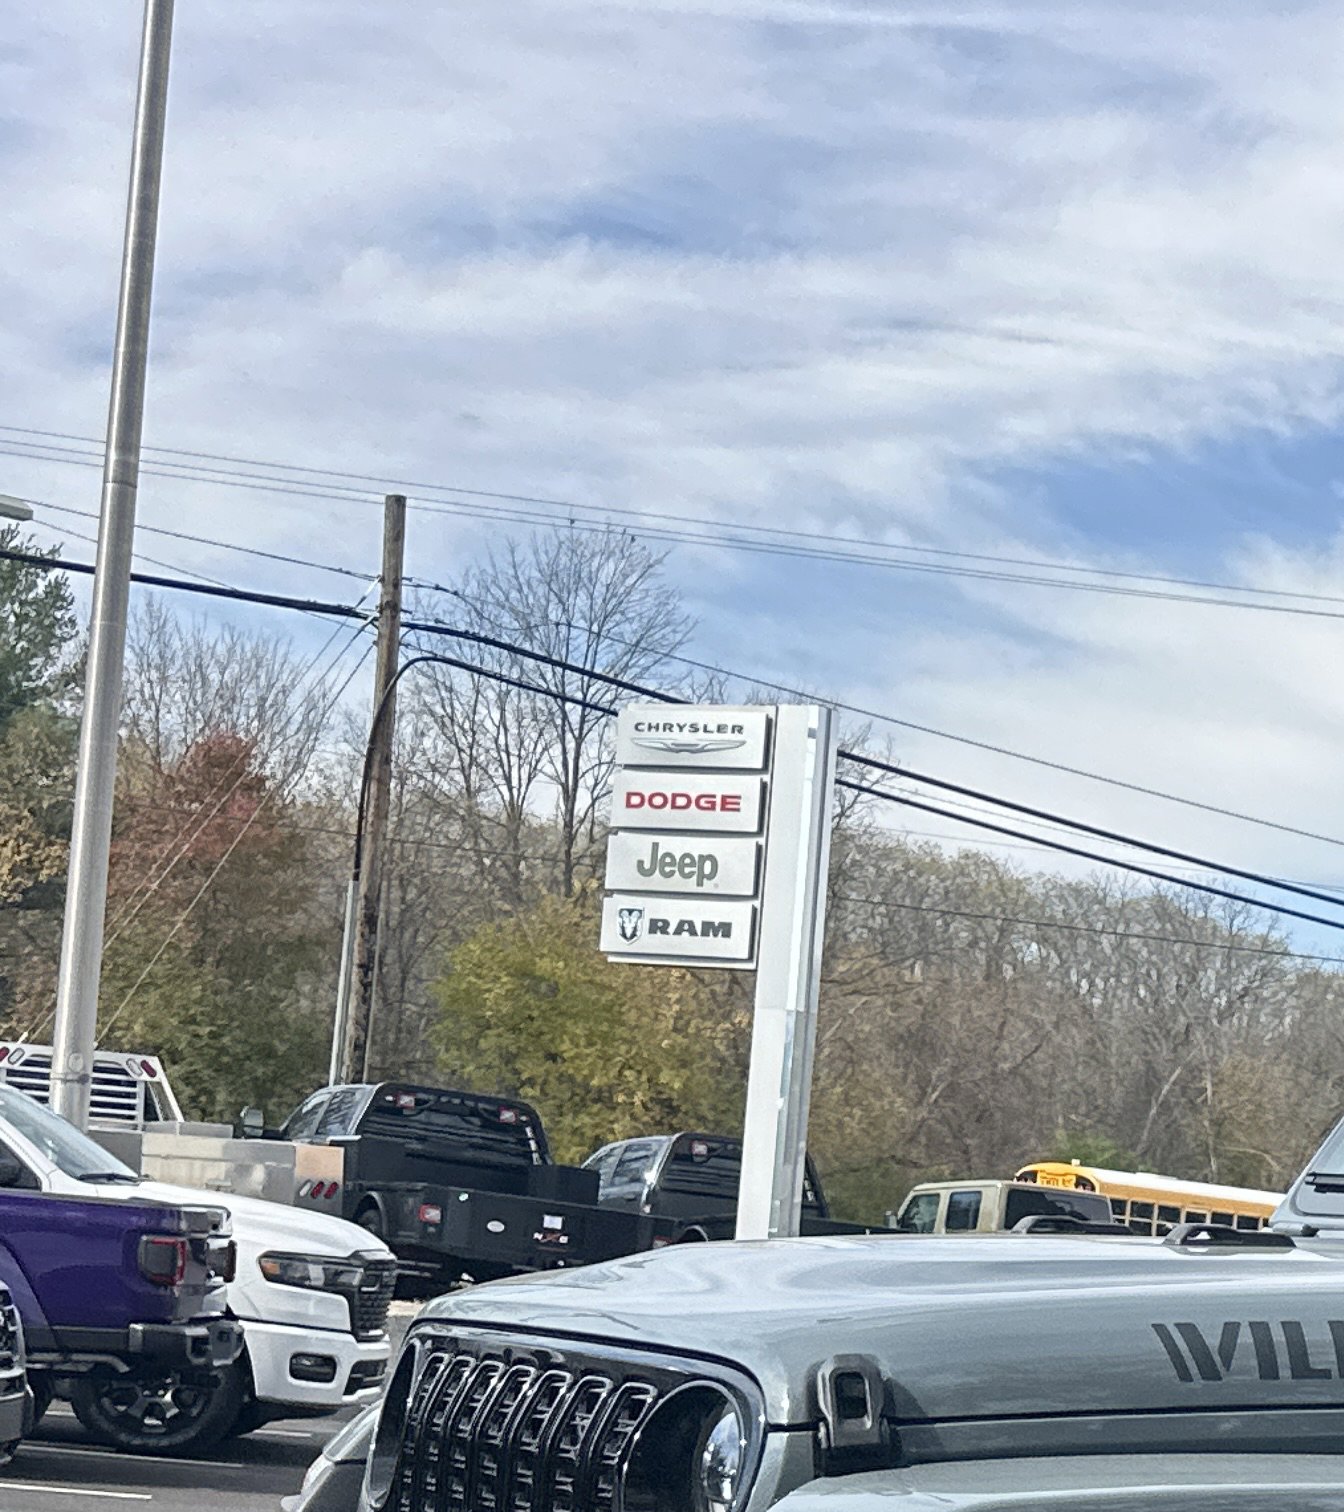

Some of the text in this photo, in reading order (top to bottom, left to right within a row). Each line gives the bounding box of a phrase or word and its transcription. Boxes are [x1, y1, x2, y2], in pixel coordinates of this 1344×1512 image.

[634, 722, 744, 735] CHRYSLER
[625, 791, 742, 812] DODGE
[636, 842, 719, 887] Jeep
[649, 918, 732, 938] RAM
